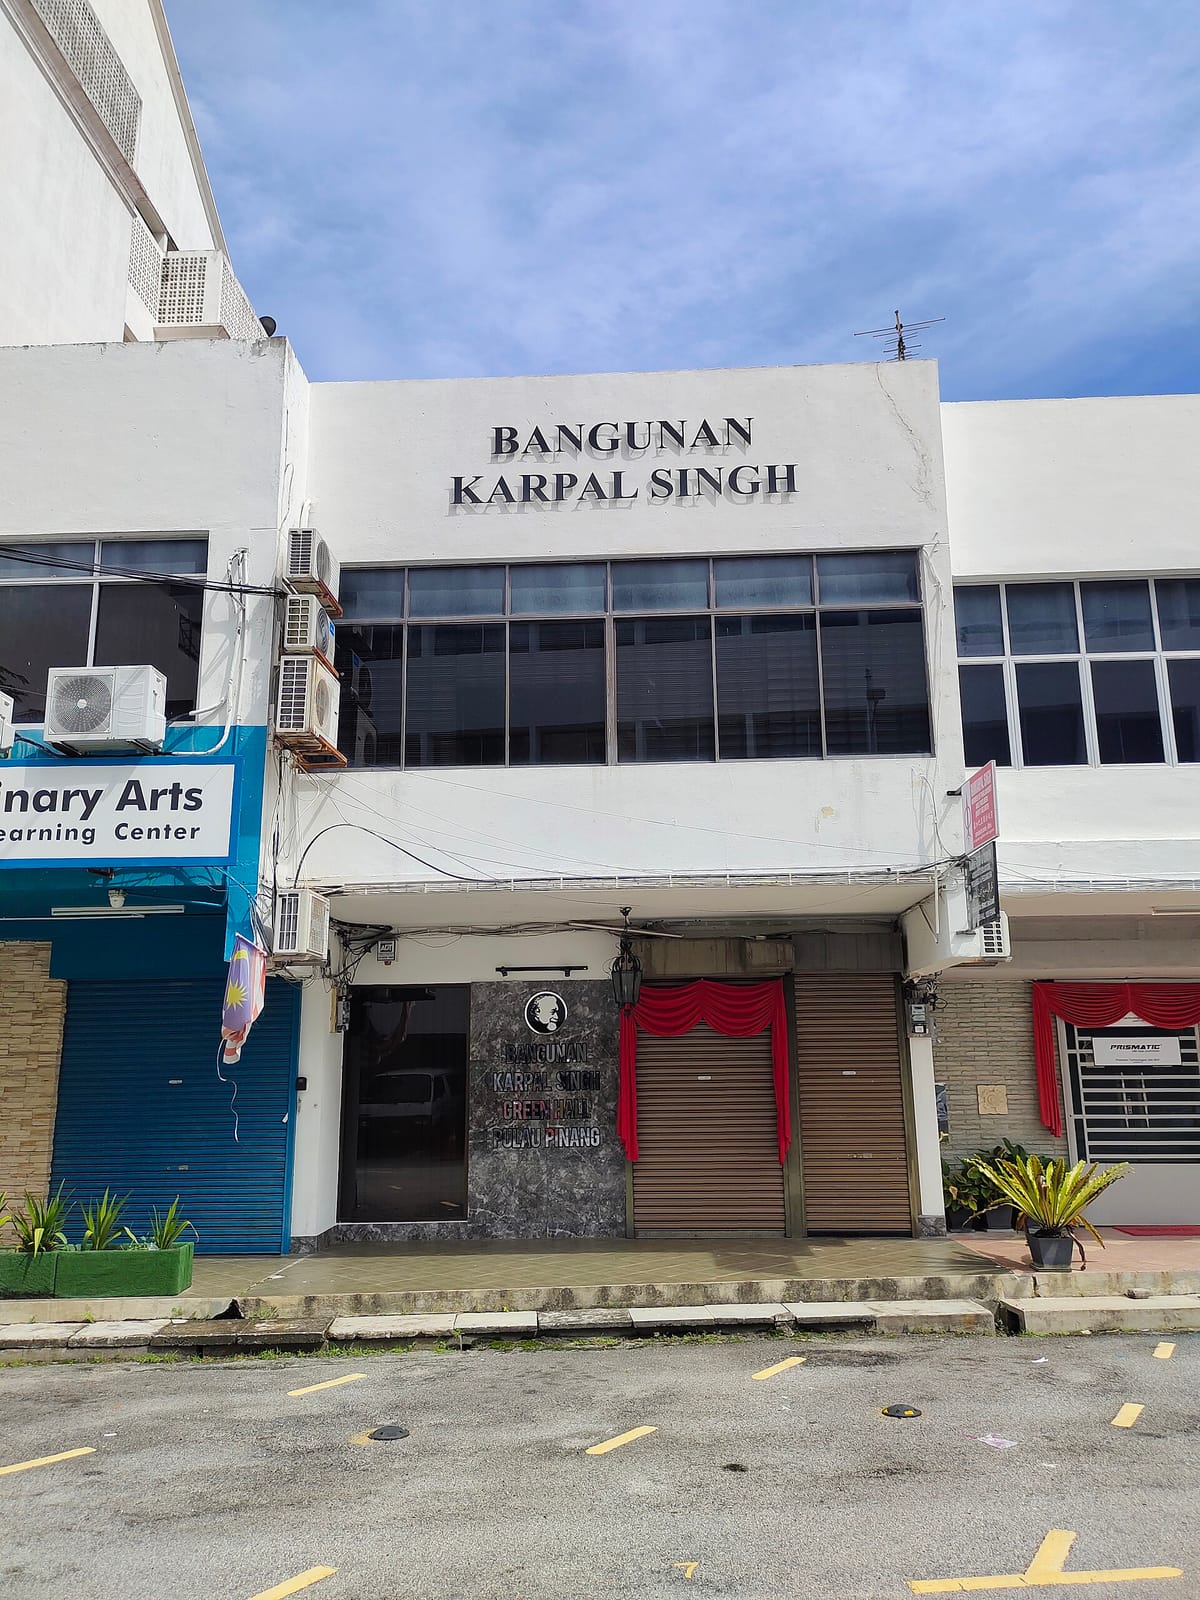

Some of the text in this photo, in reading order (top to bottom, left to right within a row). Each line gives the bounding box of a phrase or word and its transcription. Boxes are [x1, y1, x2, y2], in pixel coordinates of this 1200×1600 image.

[491, 417, 755, 455] BANGUNAN
[450, 463, 800, 505] KARPAL SINGH
[0, 779, 203, 821] nary Arts
[114, 822, 201, 841] Center
[506, 1042, 587, 1064] BANGUNAN
[493, 1070, 600, 1092] KARPAL SINGH
[503, 1098, 592, 1120] GREEN HALL
[492, 1126, 601, 1149] PULAU PINANG
